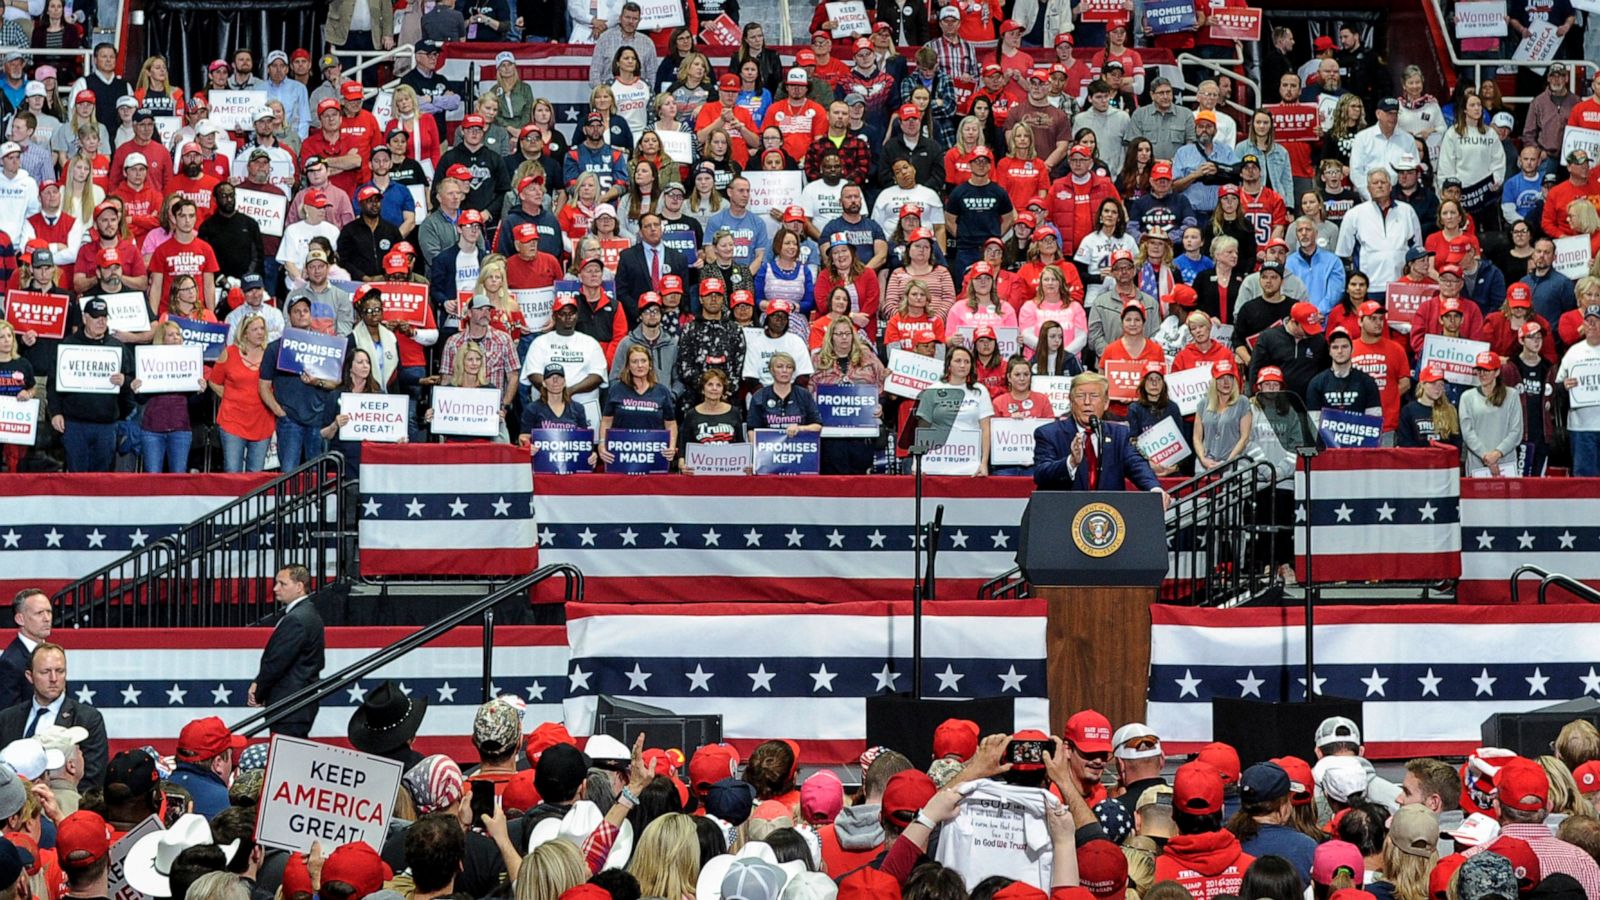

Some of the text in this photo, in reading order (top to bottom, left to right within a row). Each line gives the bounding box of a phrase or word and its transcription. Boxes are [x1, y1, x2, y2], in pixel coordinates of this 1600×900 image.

[1146, 5, 1193, 18] PROMISES
[1460, 11, 1503, 23] Women
[833, 14, 867, 23] AMERICA
[1158, 16, 1182, 25] KEPT
[1215, 13, 1258, 23] TRUMP
[1525, 31, 1538, 53] KEEP
[225, 96, 250, 104] KEEP
[616, 91, 645, 99] TRUMP
[213, 106, 252, 114] AMERIC
[620, 101, 644, 112] 2020
[1458, 137, 1495, 146] TRUMP
[762, 178, 781, 186] Text
[1460, 182, 1496, 202] OMISES
[243, 196, 269, 206] KEEP
[237, 204, 281, 219] MERICA
[1141, 214, 1176, 223] TRUMP
[663, 240, 695, 250] MISES
[1096, 242, 1124, 253] PRAY
[166, 254, 206, 265] TRUMP
[382, 292, 424, 303] RUMP
[11, 301, 63, 316] TRUMP
[15, 312, 58, 322] PENCE
[897, 321, 933, 331] WOMEN
[282, 338, 342, 358] PROMISES
[294, 352, 326, 367] KEPT
[1429, 344, 1475, 364] Latino
[69, 359, 117, 372] VETERANS
[141, 358, 198, 373] Women
[894, 358, 939, 382] Latino
[1352, 363, 1388, 375] Trump
[892, 374, 912, 385] FOR
[1110, 371, 1140, 380] TRU
[622, 398, 659, 408] Women
[818, 395, 875, 406] PROMISES
[1182, 395, 1197, 403] FOR
[360, 402, 389, 410] KEEP
[438, 399, 495, 416] Women
[832, 406, 861, 417] KEPT
[766, 414, 801, 424] Women
[0, 422, 30, 433] TRUMP
[353, 424, 395, 433] GREAT!
[697, 422, 735, 436] Trump
[1321, 420, 1380, 438] PROMISES
[1417, 422, 1434, 430] TRU
[1333, 432, 1364, 447] KEPT
[534, 441, 593, 451] PROMISES
[607, 441, 668, 452] PROMISES
[757, 442, 818, 453] PROMISES
[920, 439, 976, 456] Women
[549, 452, 580, 463] KEPT
[619, 452, 655, 463] MADE
[772, 453, 803, 464] KEPT
[1152, 442, 1180, 464] TRUMP
[690, 452, 747, 467] Women
[310, 760, 366, 789] KEEP
[272, 781, 384, 826] AMERICA
[288, 814, 366, 844] GREAT!
[974, 838, 981, 846] In
[983, 838, 996, 847] God
[997, 840, 1008, 849] We
